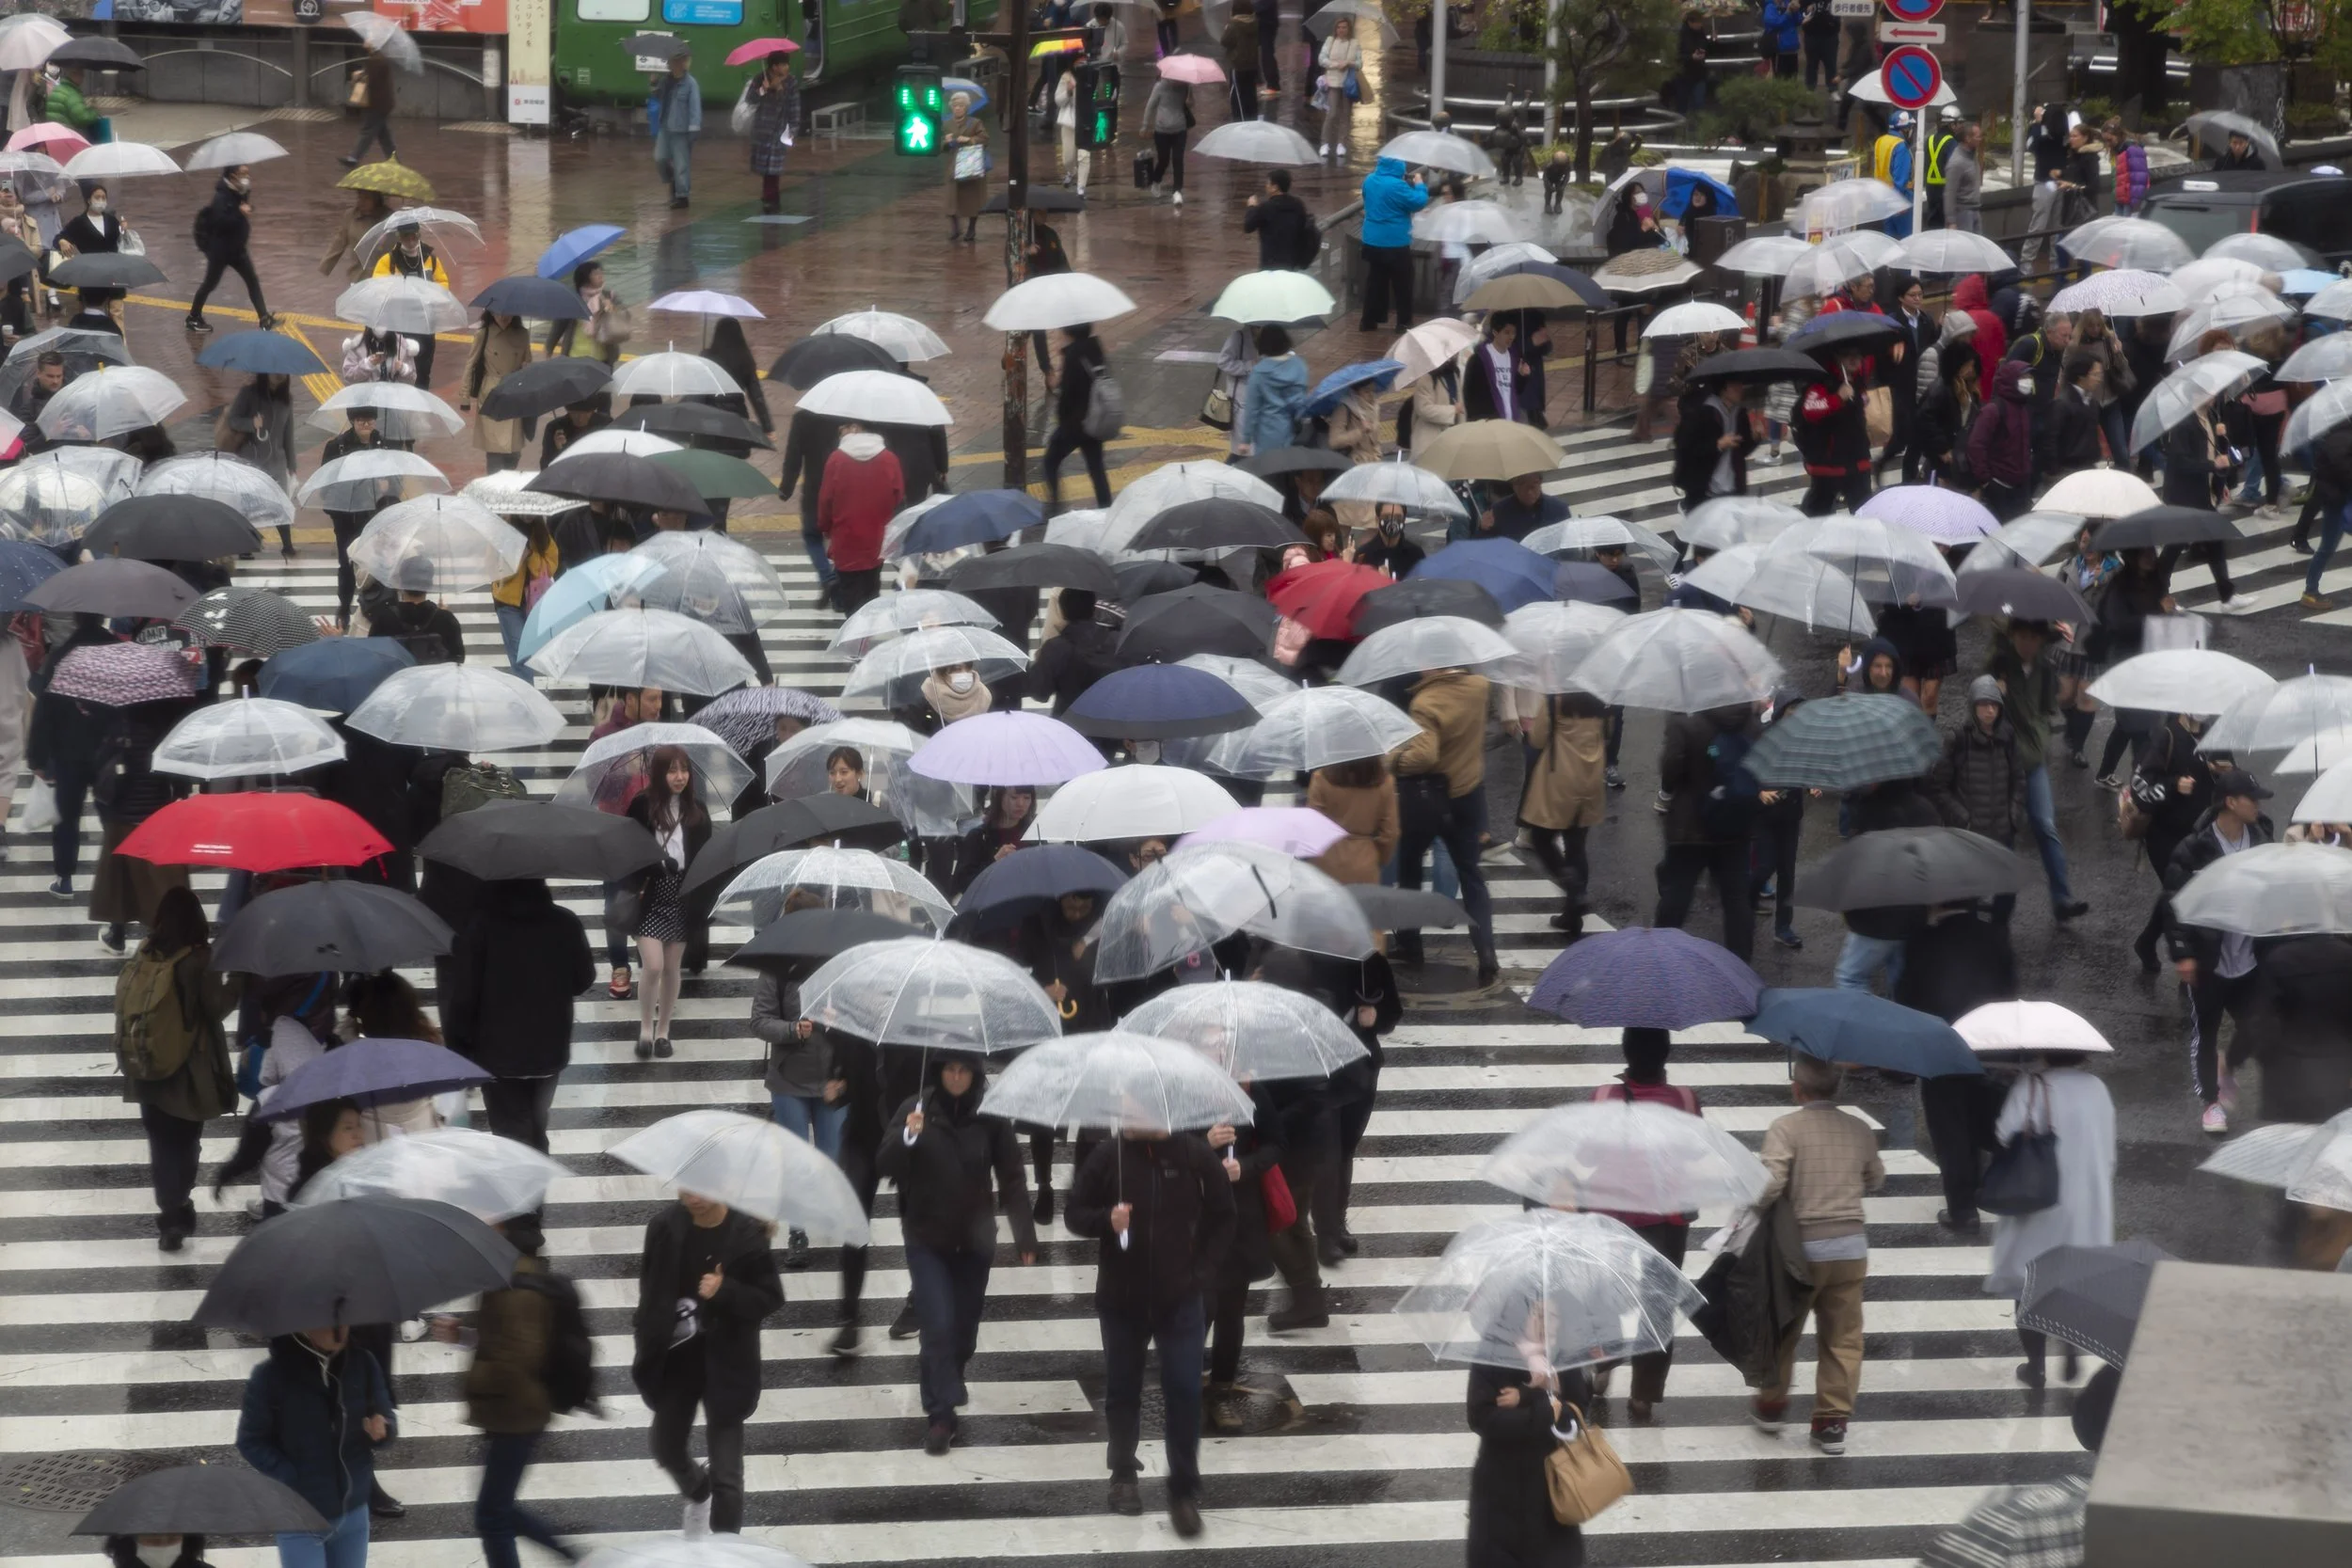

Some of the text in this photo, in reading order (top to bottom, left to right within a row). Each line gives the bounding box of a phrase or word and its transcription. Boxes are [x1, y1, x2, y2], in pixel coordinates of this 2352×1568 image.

[1835, 3, 1871, 13] 歩行者優先
